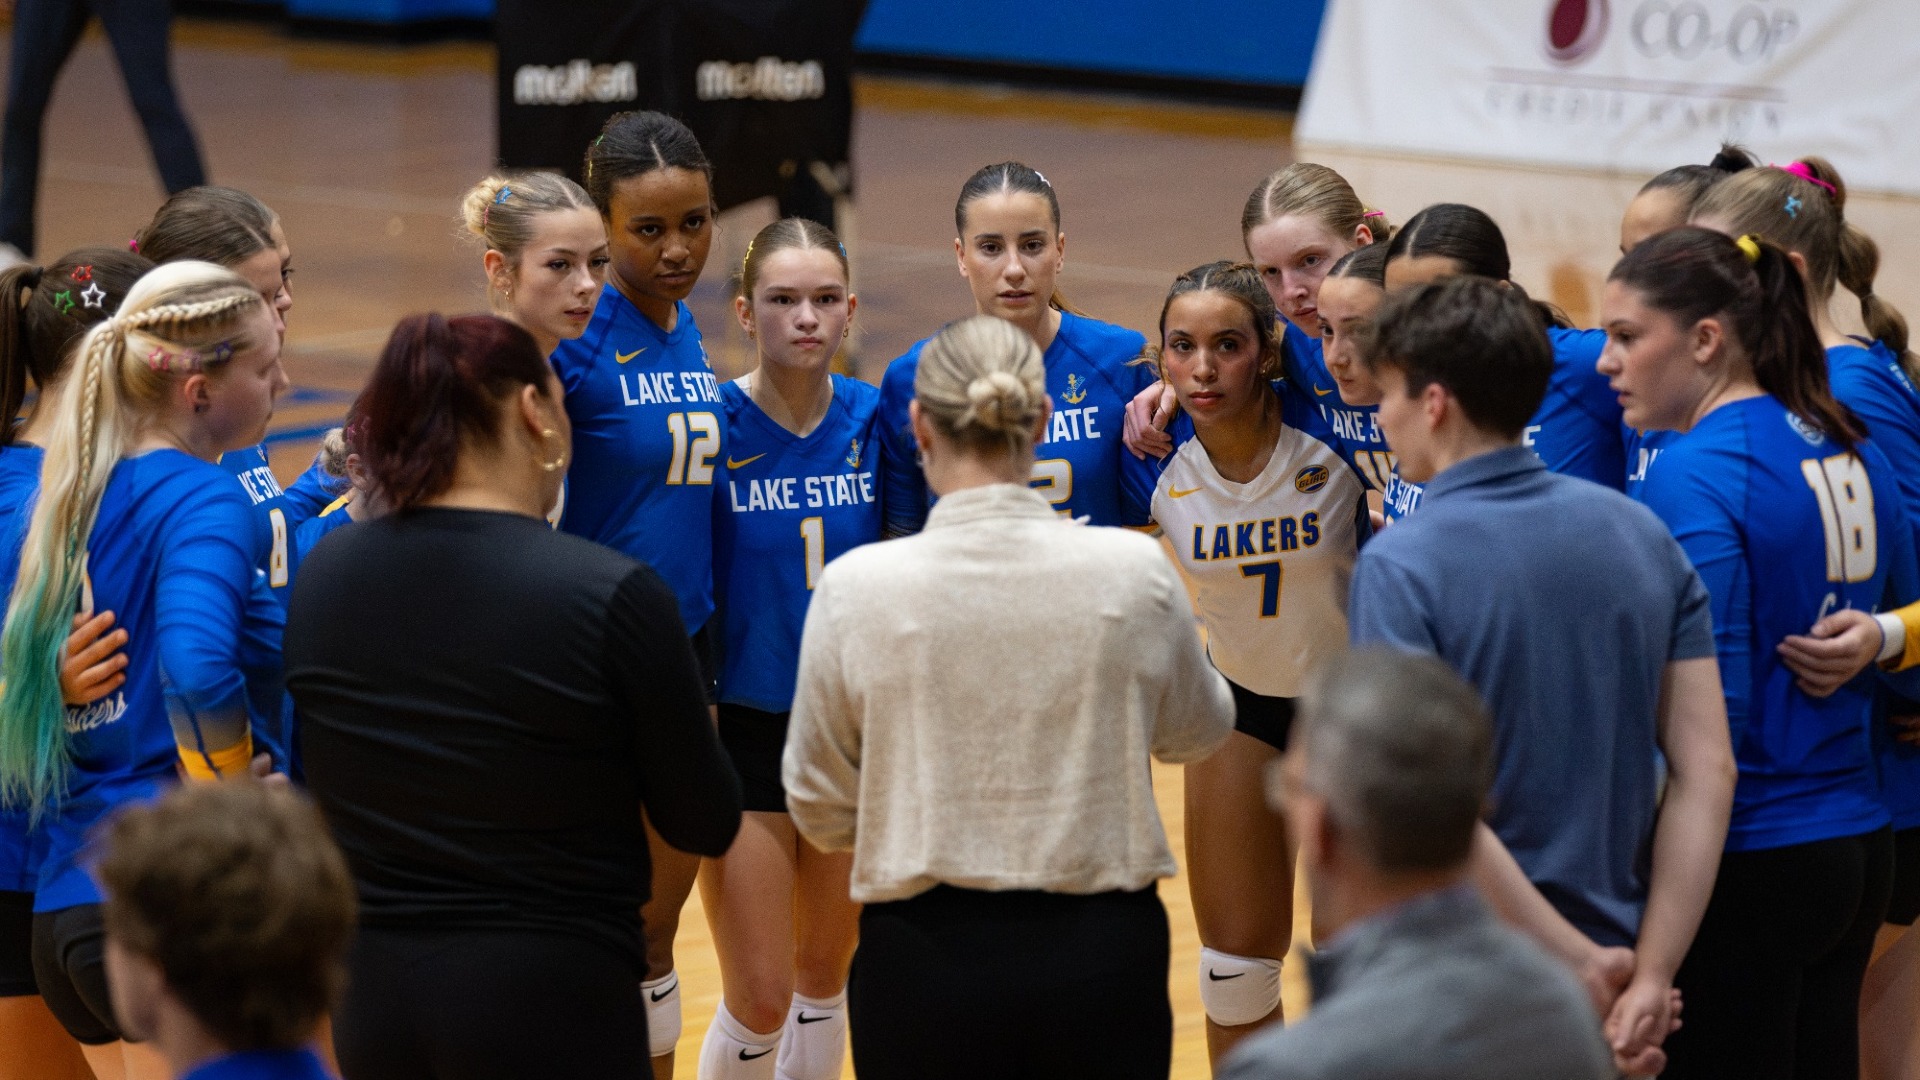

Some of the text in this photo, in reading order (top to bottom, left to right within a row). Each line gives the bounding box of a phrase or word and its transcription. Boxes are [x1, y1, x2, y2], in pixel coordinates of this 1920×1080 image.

[697, 56, 825, 101] molten
[619, 371, 722, 406] LAKE STAT
[1044, 406, 1100, 443] ATE
[666, 411, 720, 485] 12
[237, 470, 266, 505] KE
[729, 472, 875, 512] LAKE STATE
[1394, 479, 1423, 516] STAT
[1192, 509, 1322, 562] LAKERS
[1800, 451, 1877, 583] 18
[269, 507, 289, 588] 8
[800, 516, 824, 590] 1
[1238, 559, 1284, 619] 7
[64, 690, 128, 734] akers
